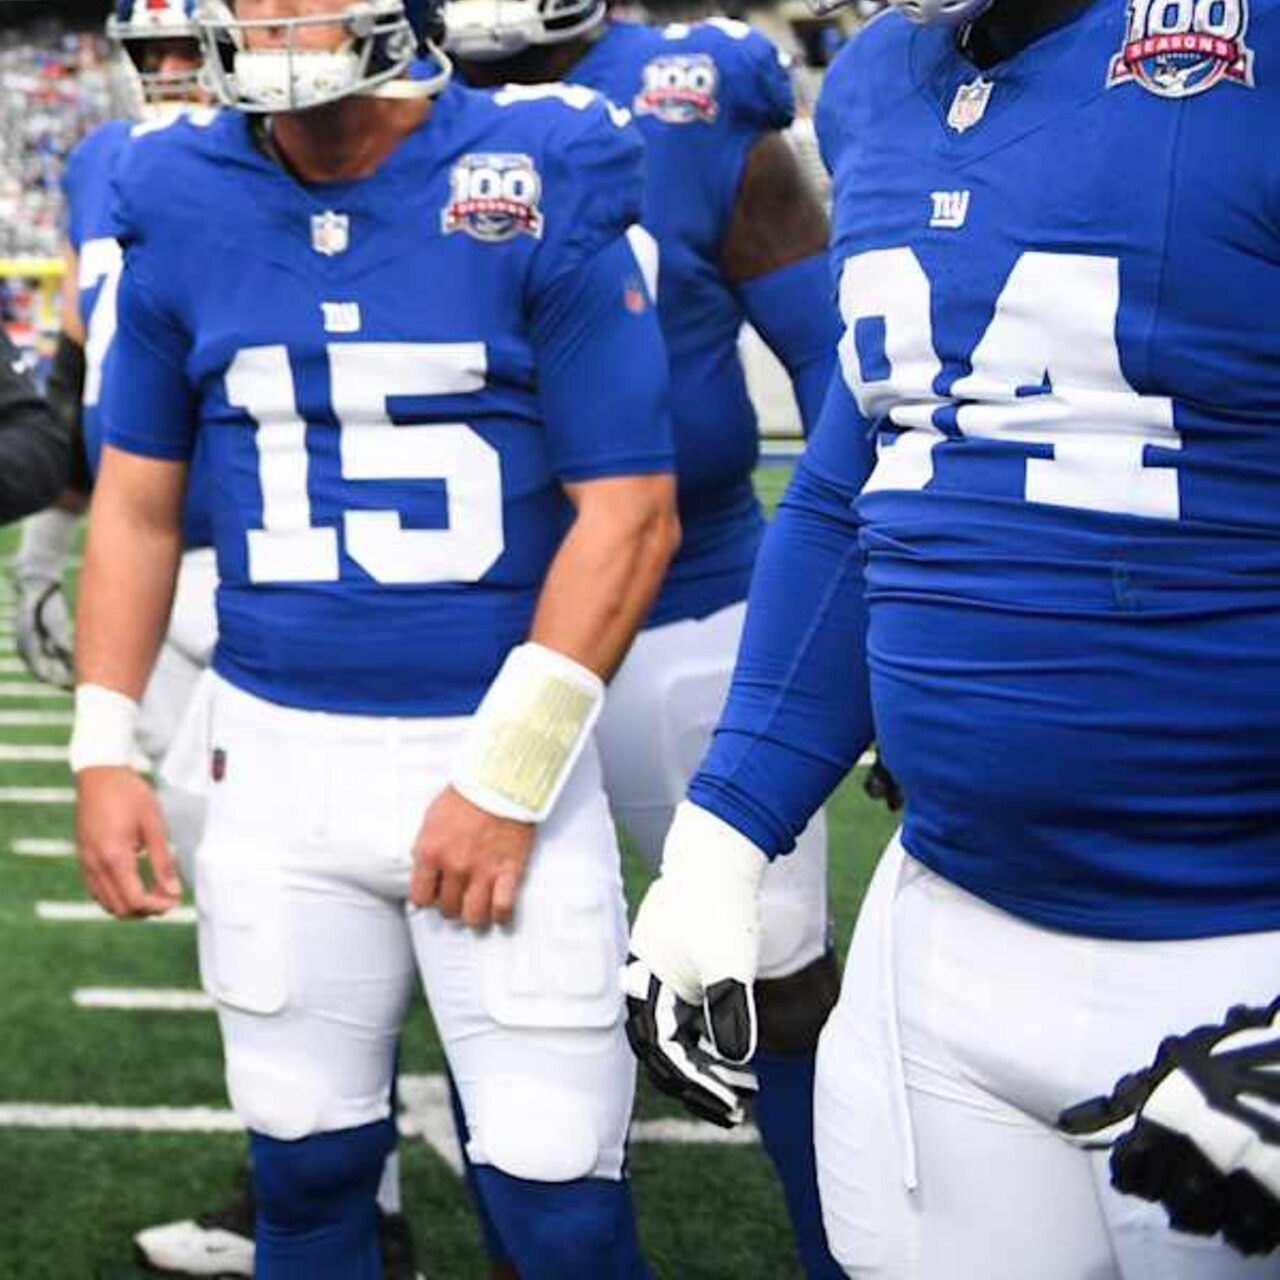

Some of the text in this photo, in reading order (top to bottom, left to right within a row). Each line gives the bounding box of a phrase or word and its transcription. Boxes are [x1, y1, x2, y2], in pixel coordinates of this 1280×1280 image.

[1127, 36, 1229, 61] SEASONS
[453, 167, 538, 206] 100
[225, 341, 505, 584] 15
